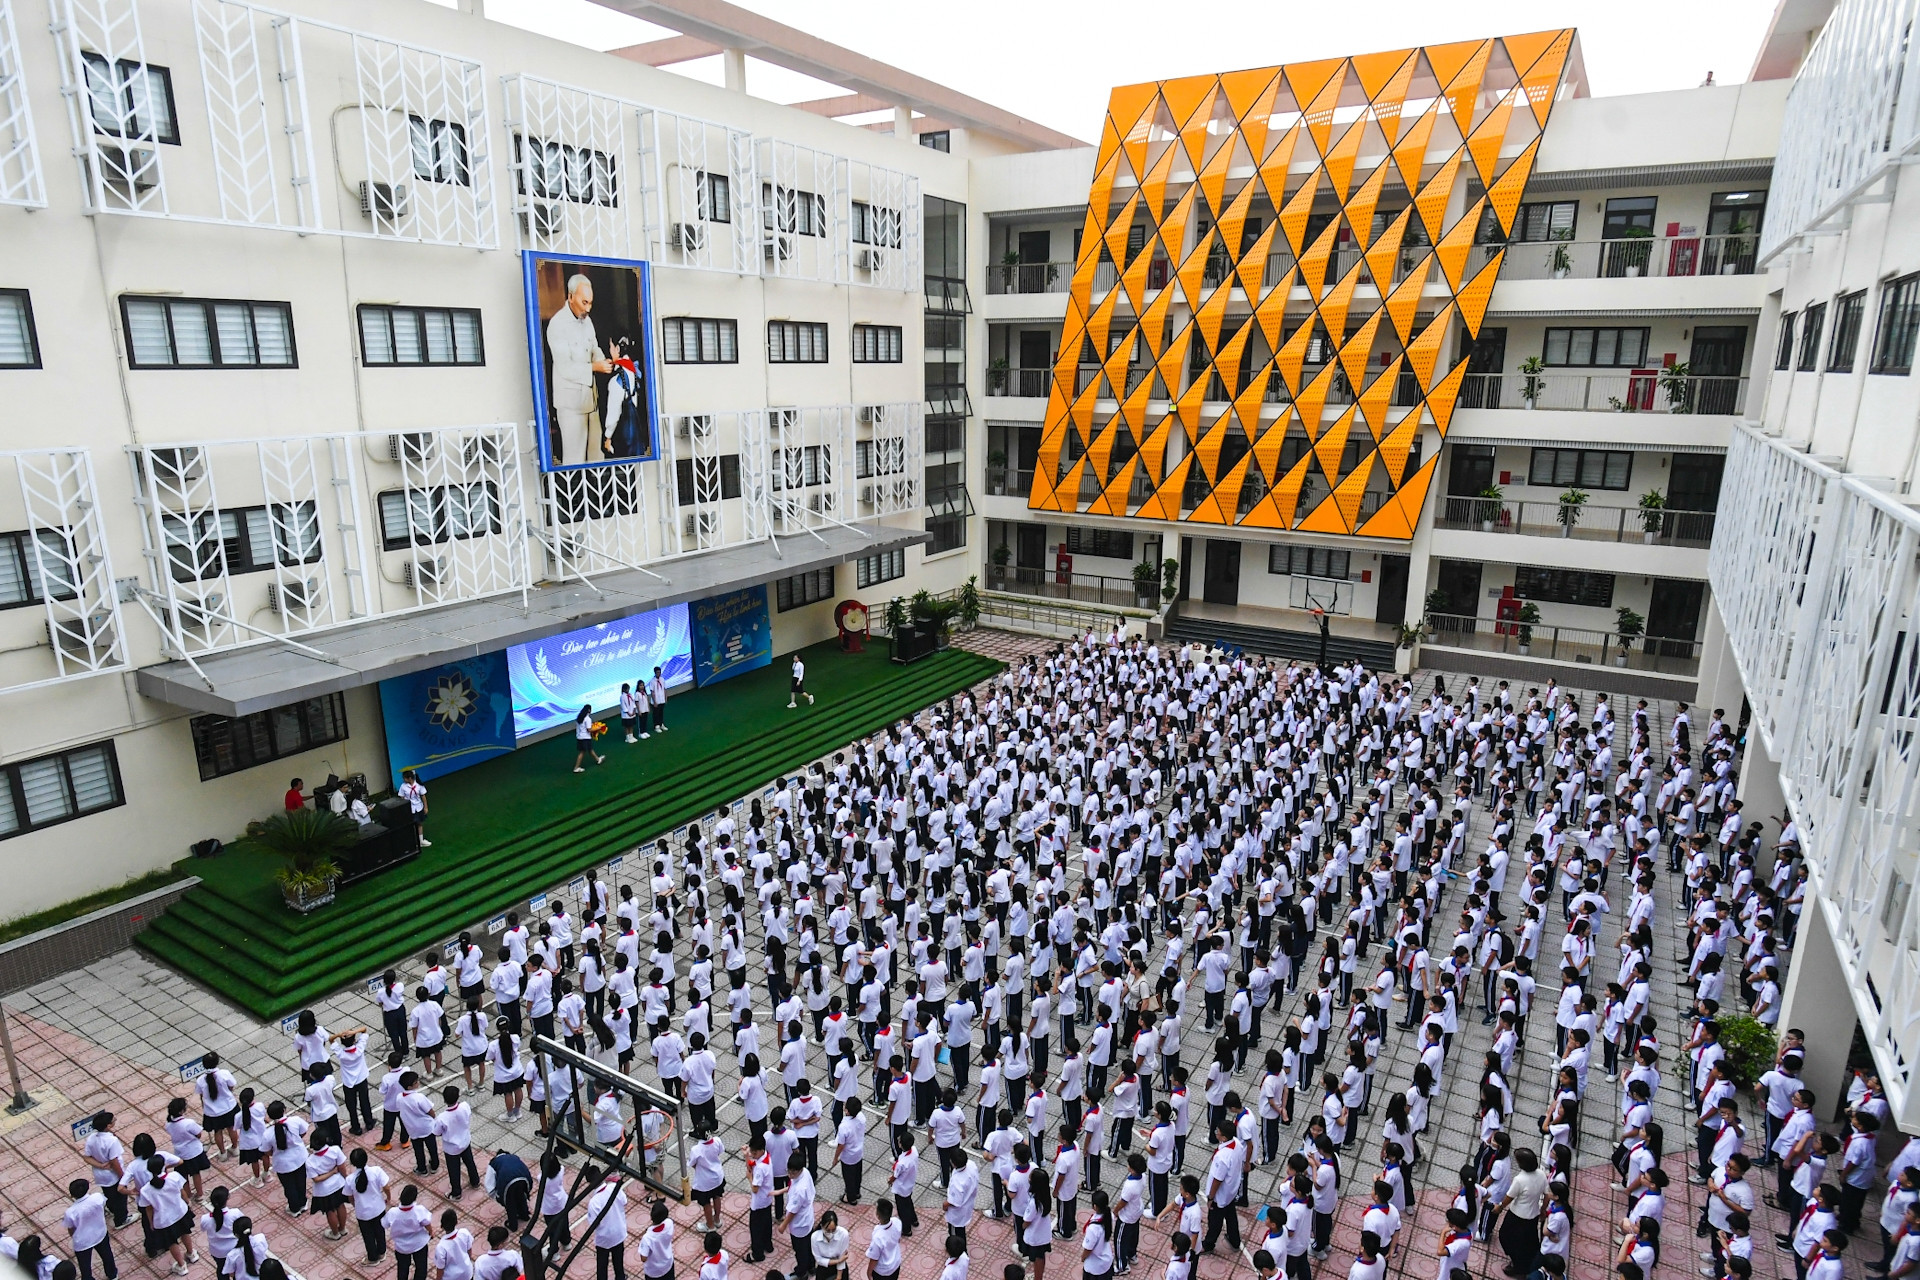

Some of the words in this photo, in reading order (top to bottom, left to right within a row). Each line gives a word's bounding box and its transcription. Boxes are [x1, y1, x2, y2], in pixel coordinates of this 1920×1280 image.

[633, 641, 648, 654] hoa
[491, 920, 503, 932] 6A7
[371, 982, 383, 991] 6A
[286, 1021, 299, 1032] 6A
